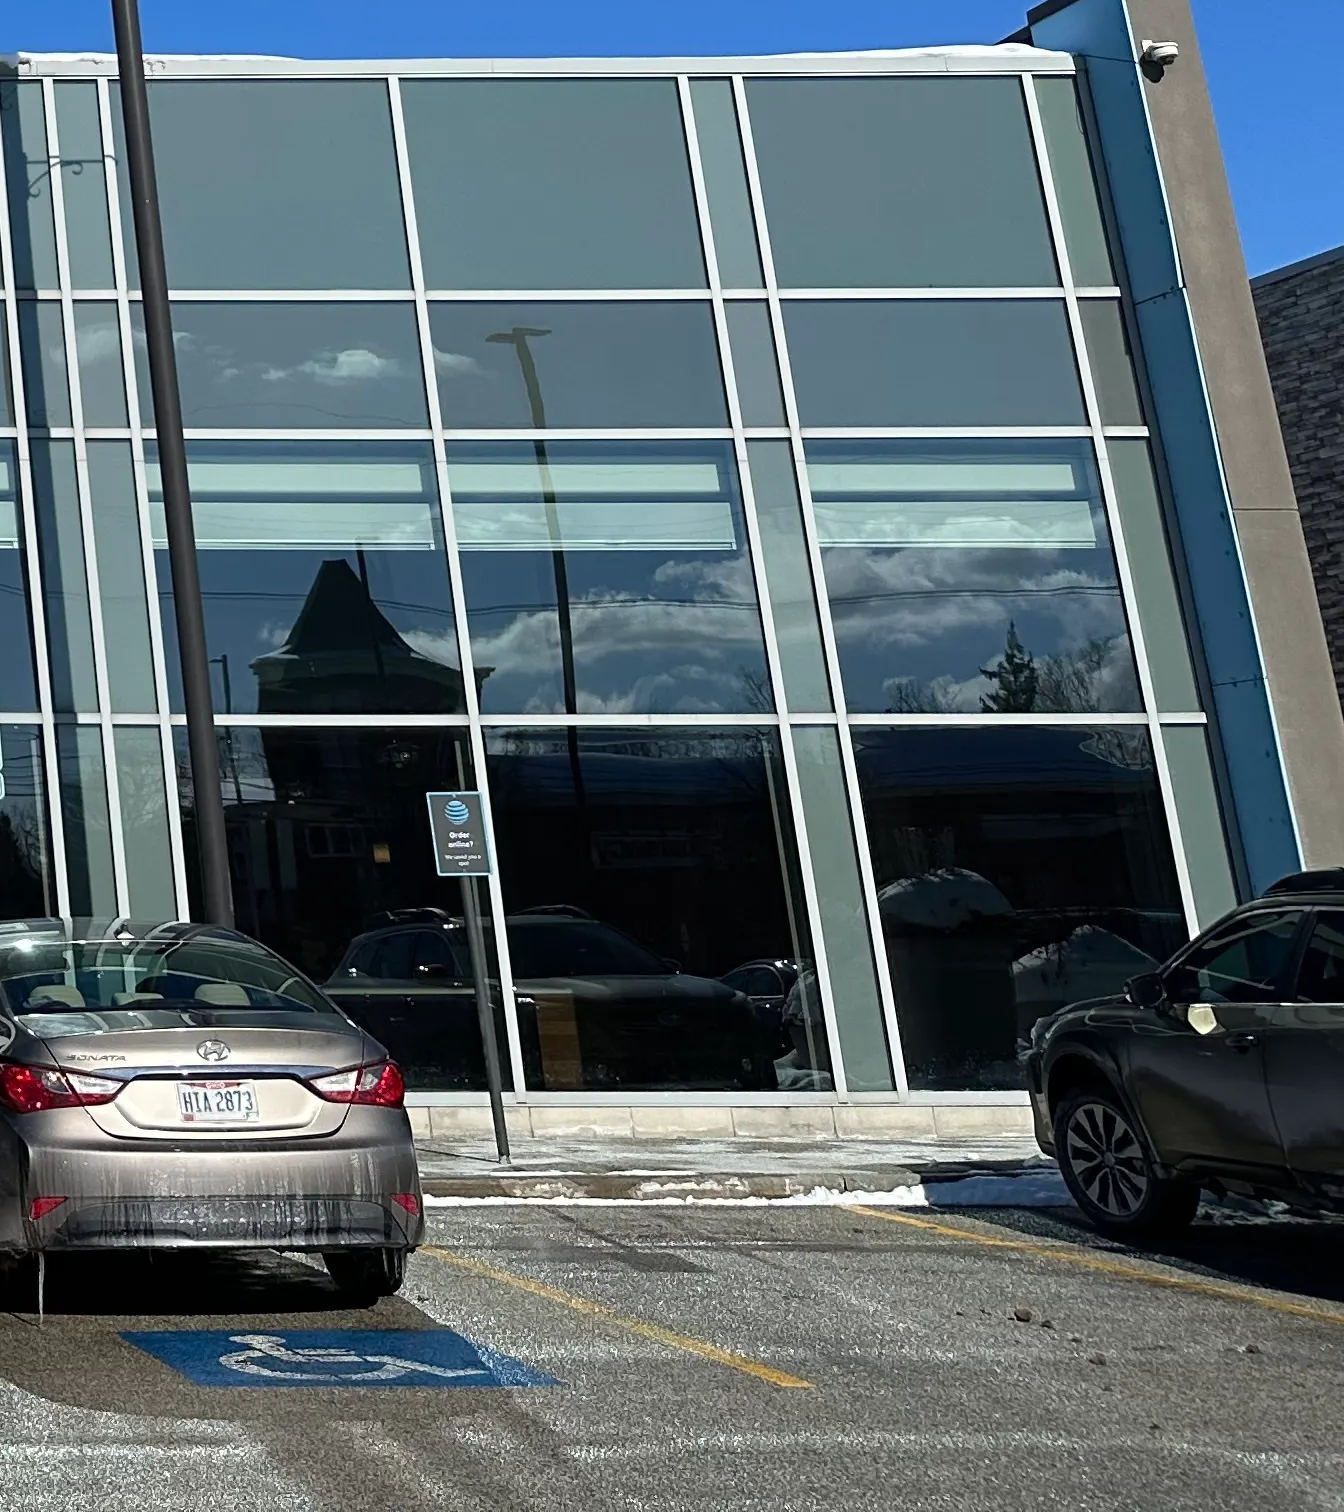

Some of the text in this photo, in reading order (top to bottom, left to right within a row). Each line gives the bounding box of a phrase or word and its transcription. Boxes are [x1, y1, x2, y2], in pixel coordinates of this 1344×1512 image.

[65, 1054, 127, 1062] SONATA
[182, 1090, 254, 1113] HIA 2873
